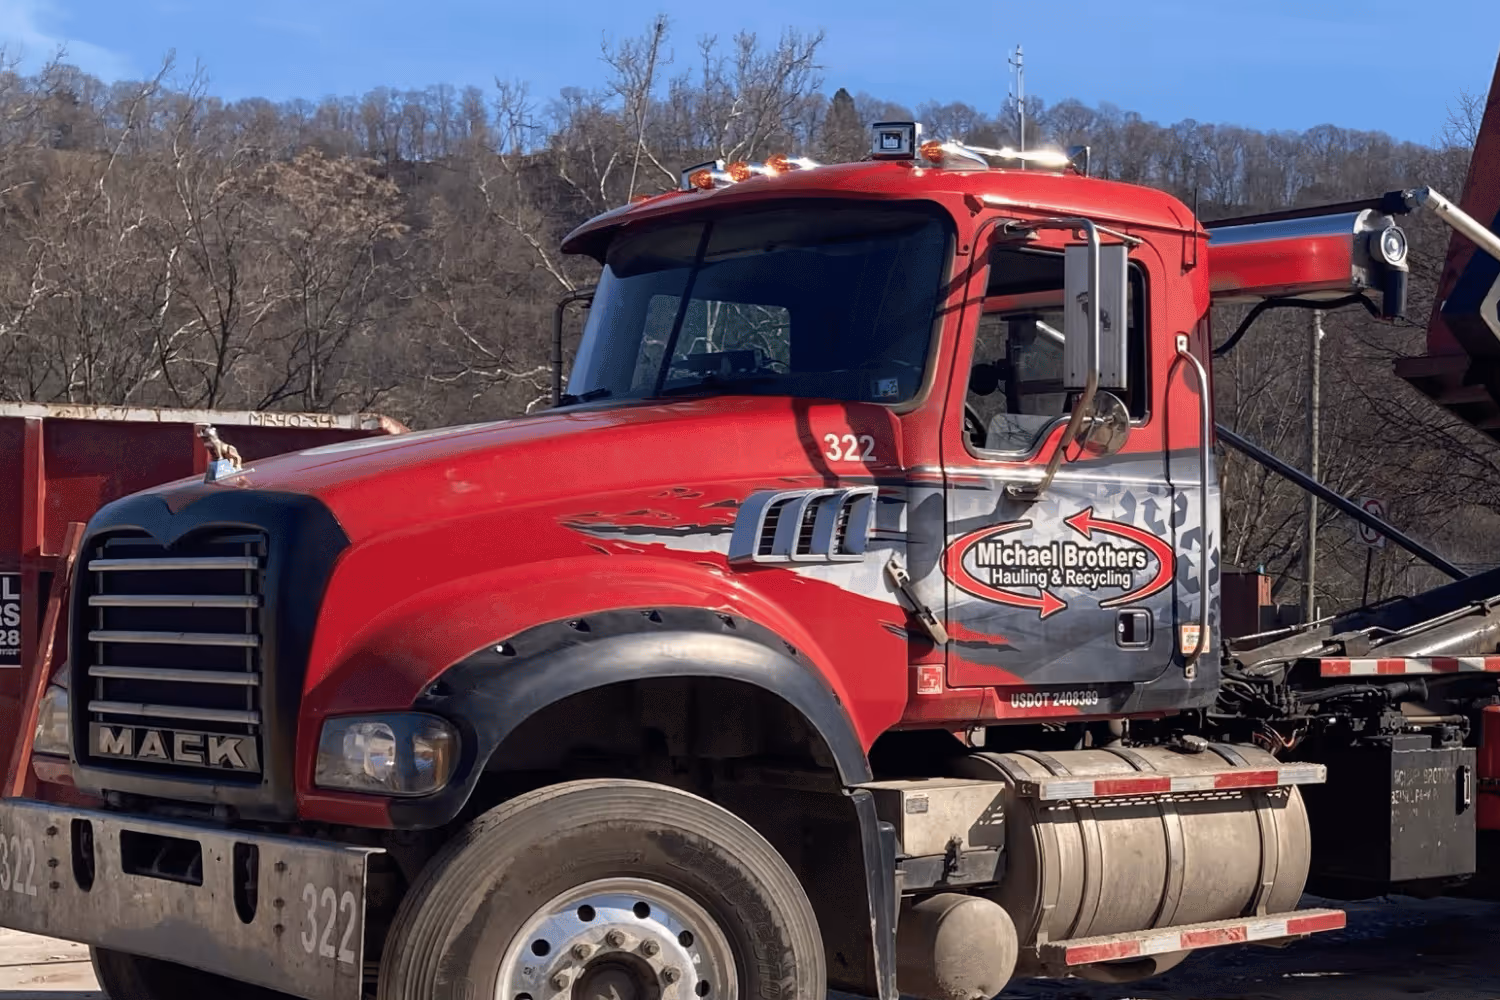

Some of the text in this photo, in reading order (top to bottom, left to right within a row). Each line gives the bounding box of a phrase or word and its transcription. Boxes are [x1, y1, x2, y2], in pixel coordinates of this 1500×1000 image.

[823, 432, 878, 462] 322
[976, 542, 1148, 568] Michael Brothers
[992, 568, 1132, 589] Hauling & Recycling
[1010, 690, 1099, 709] USDOT 2408389
[100, 725, 248, 769] MACK
[0, 834, 37, 897] 322
[300, 882, 357, 965] 322
